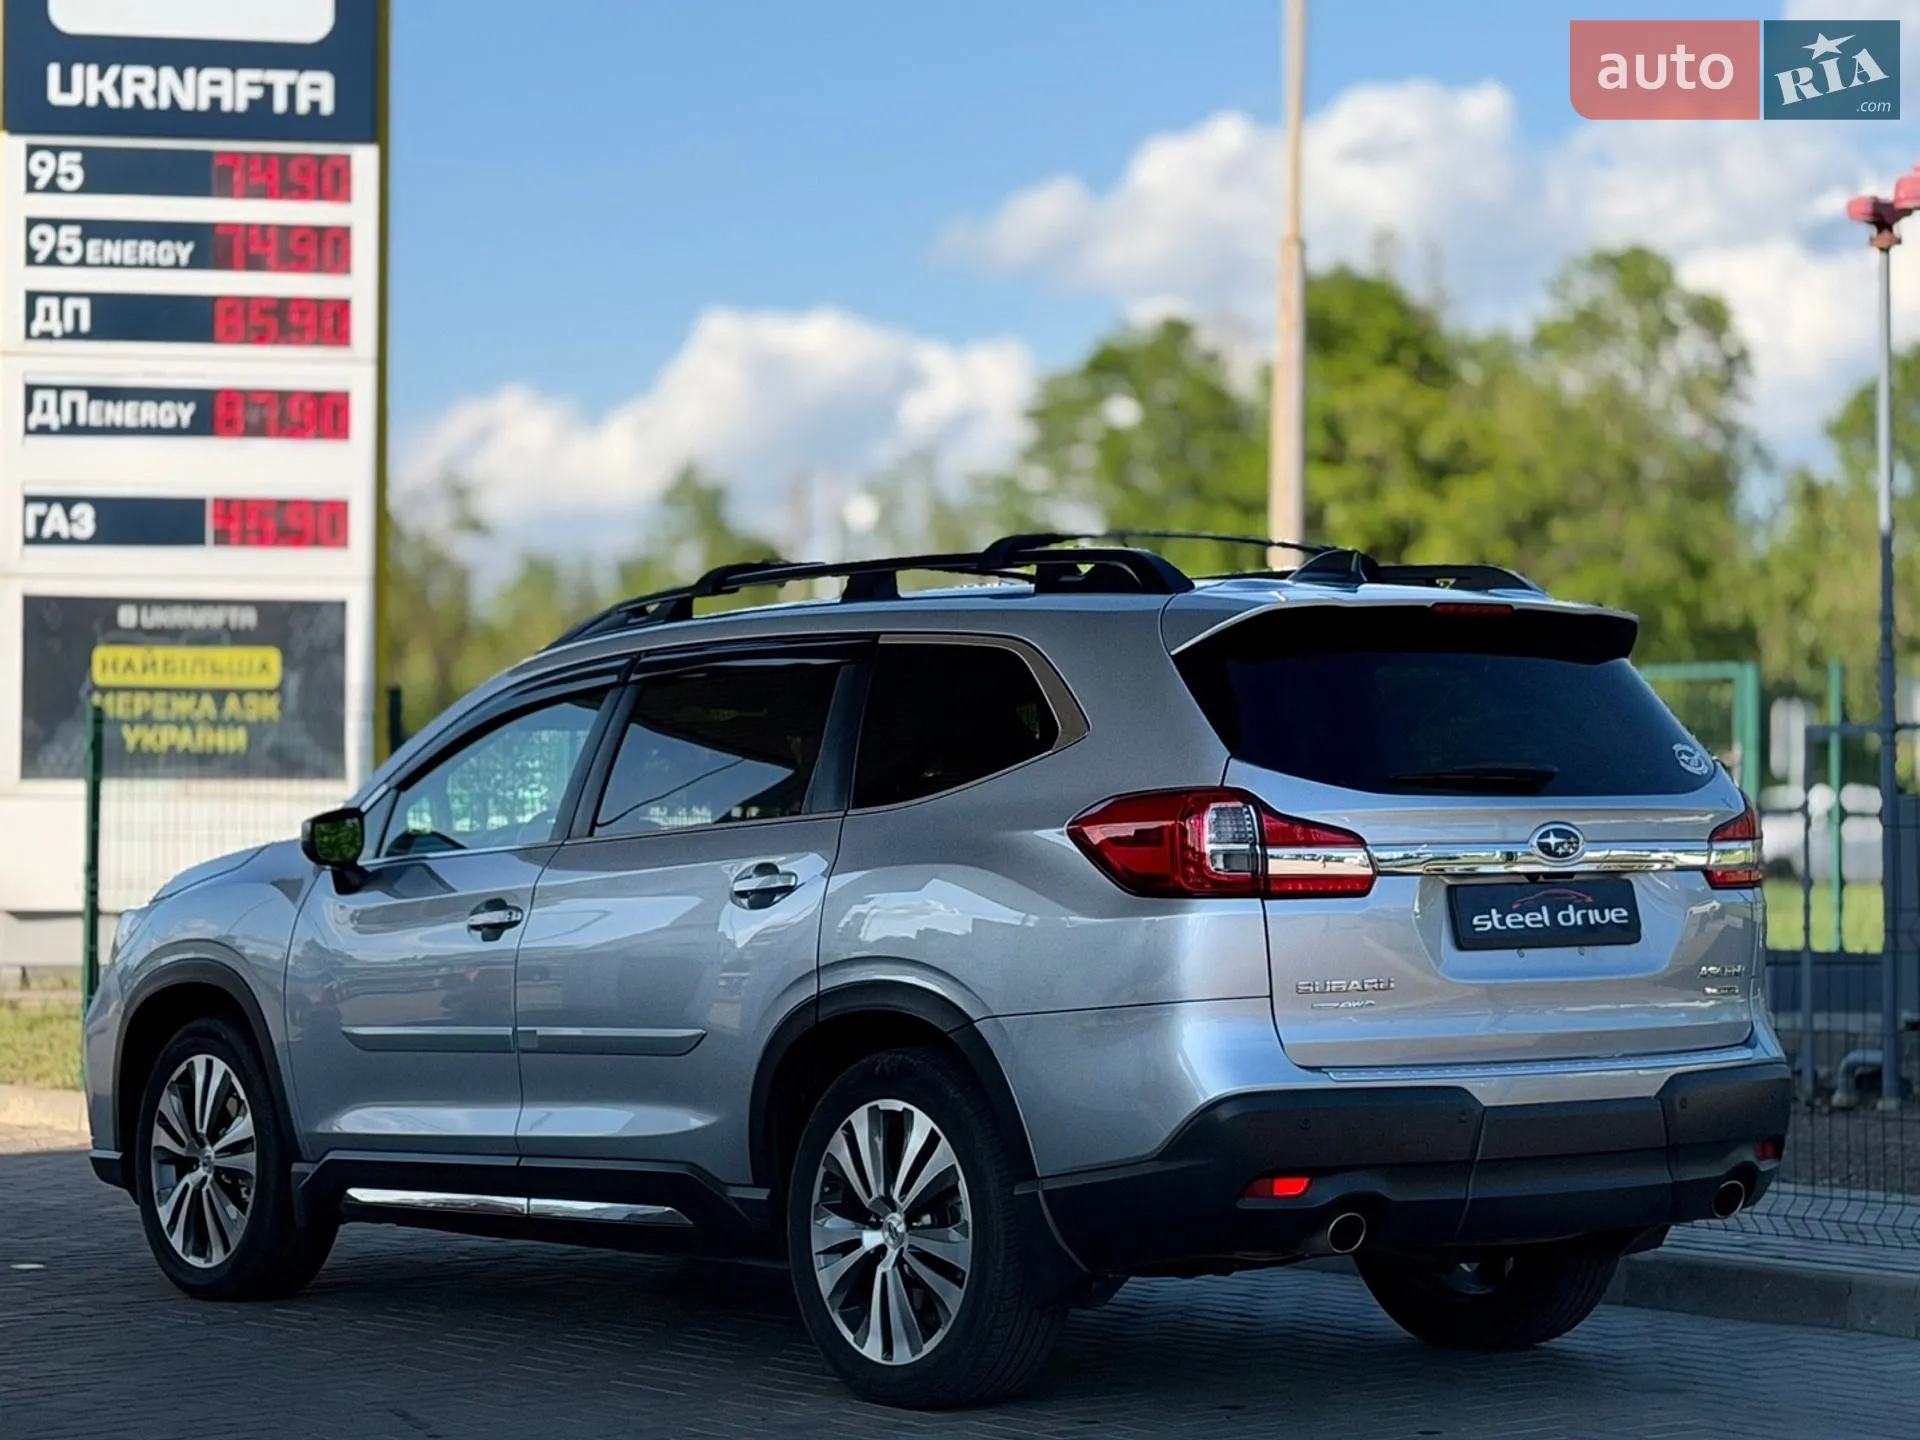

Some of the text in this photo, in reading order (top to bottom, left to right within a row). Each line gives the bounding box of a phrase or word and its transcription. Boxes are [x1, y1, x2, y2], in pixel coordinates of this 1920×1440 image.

[47, 62, 335, 116] UKRNAFTA
[28, 150, 350, 203] 95 74.90
[28, 222, 350, 275] 95 ENERGY 74.90
[30, 295, 350, 346] ДП 85.90
[213, 388, 350, 440] 87.90
[25, 503, 96, 540] ГАЗ
[101, 649, 271, 677] НАЙБІЛЬША
[1472, 904, 1629, 931] steel drive
[1296, 978, 1395, 994] SUBARU
